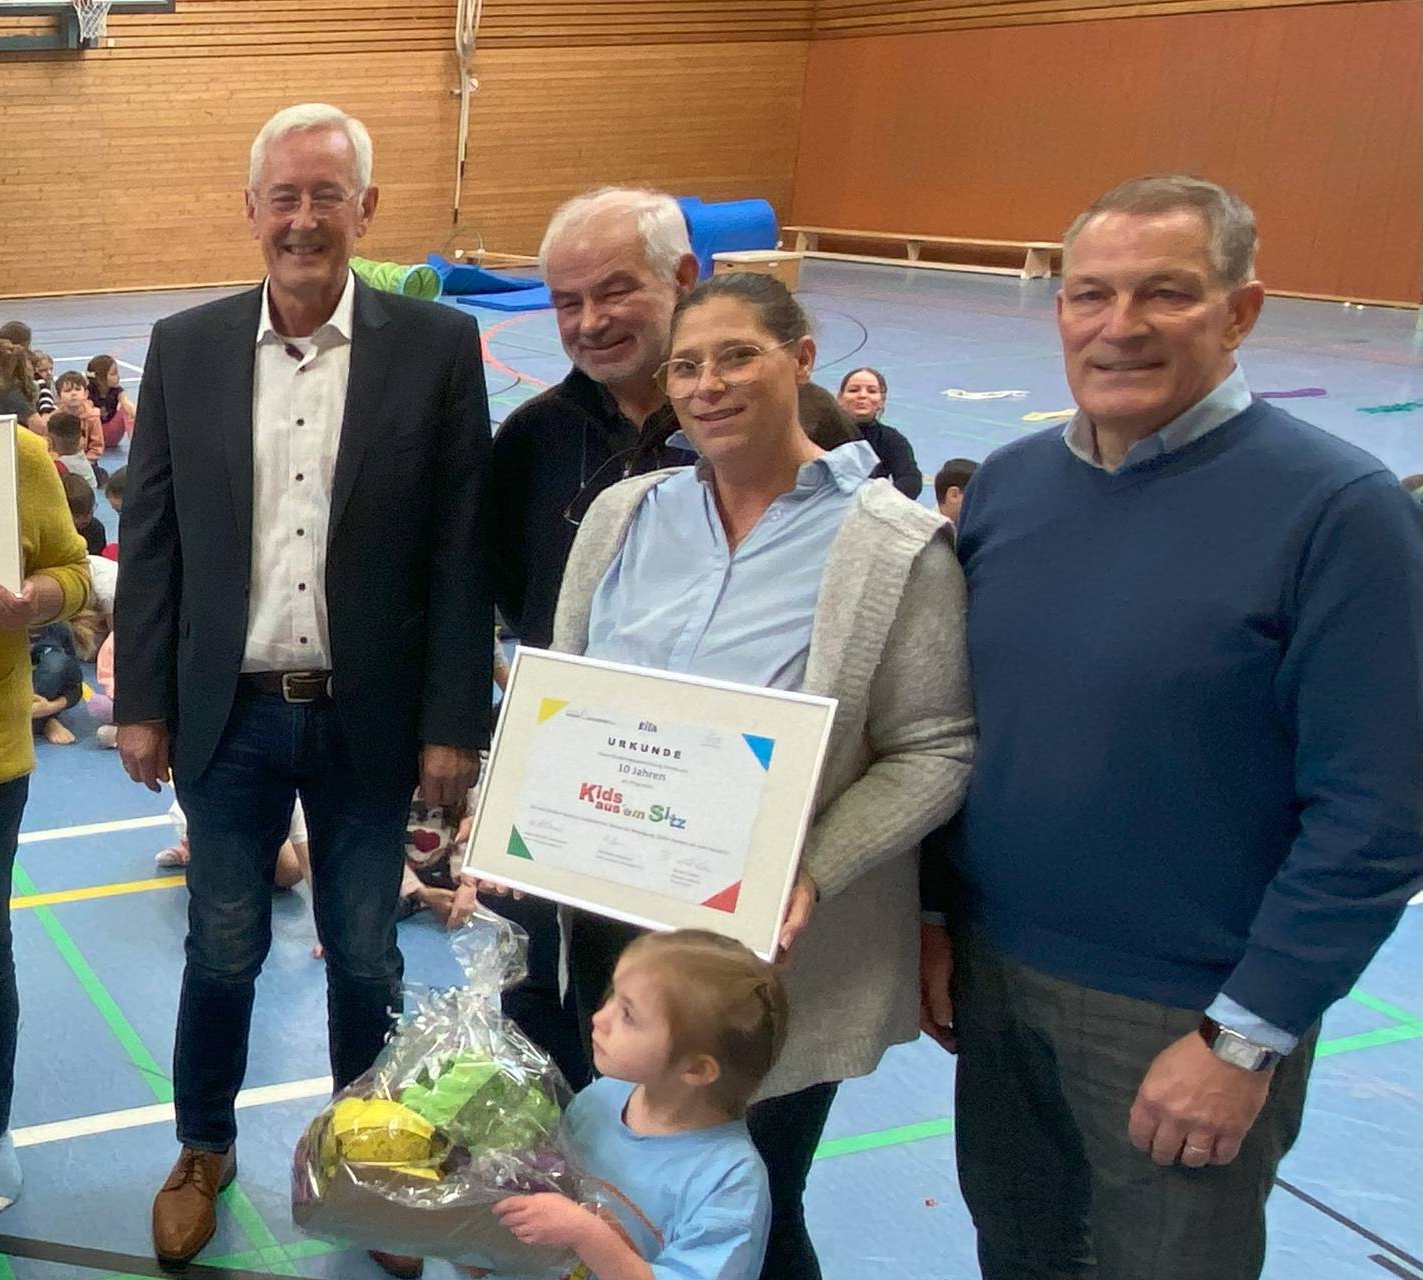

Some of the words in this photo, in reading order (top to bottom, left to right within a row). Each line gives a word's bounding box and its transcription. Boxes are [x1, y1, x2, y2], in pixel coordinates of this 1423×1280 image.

[608, 736, 682, 760] URKUNDE
[617, 763, 631, 774] 10
[632, 766, 666, 781] Jahren
